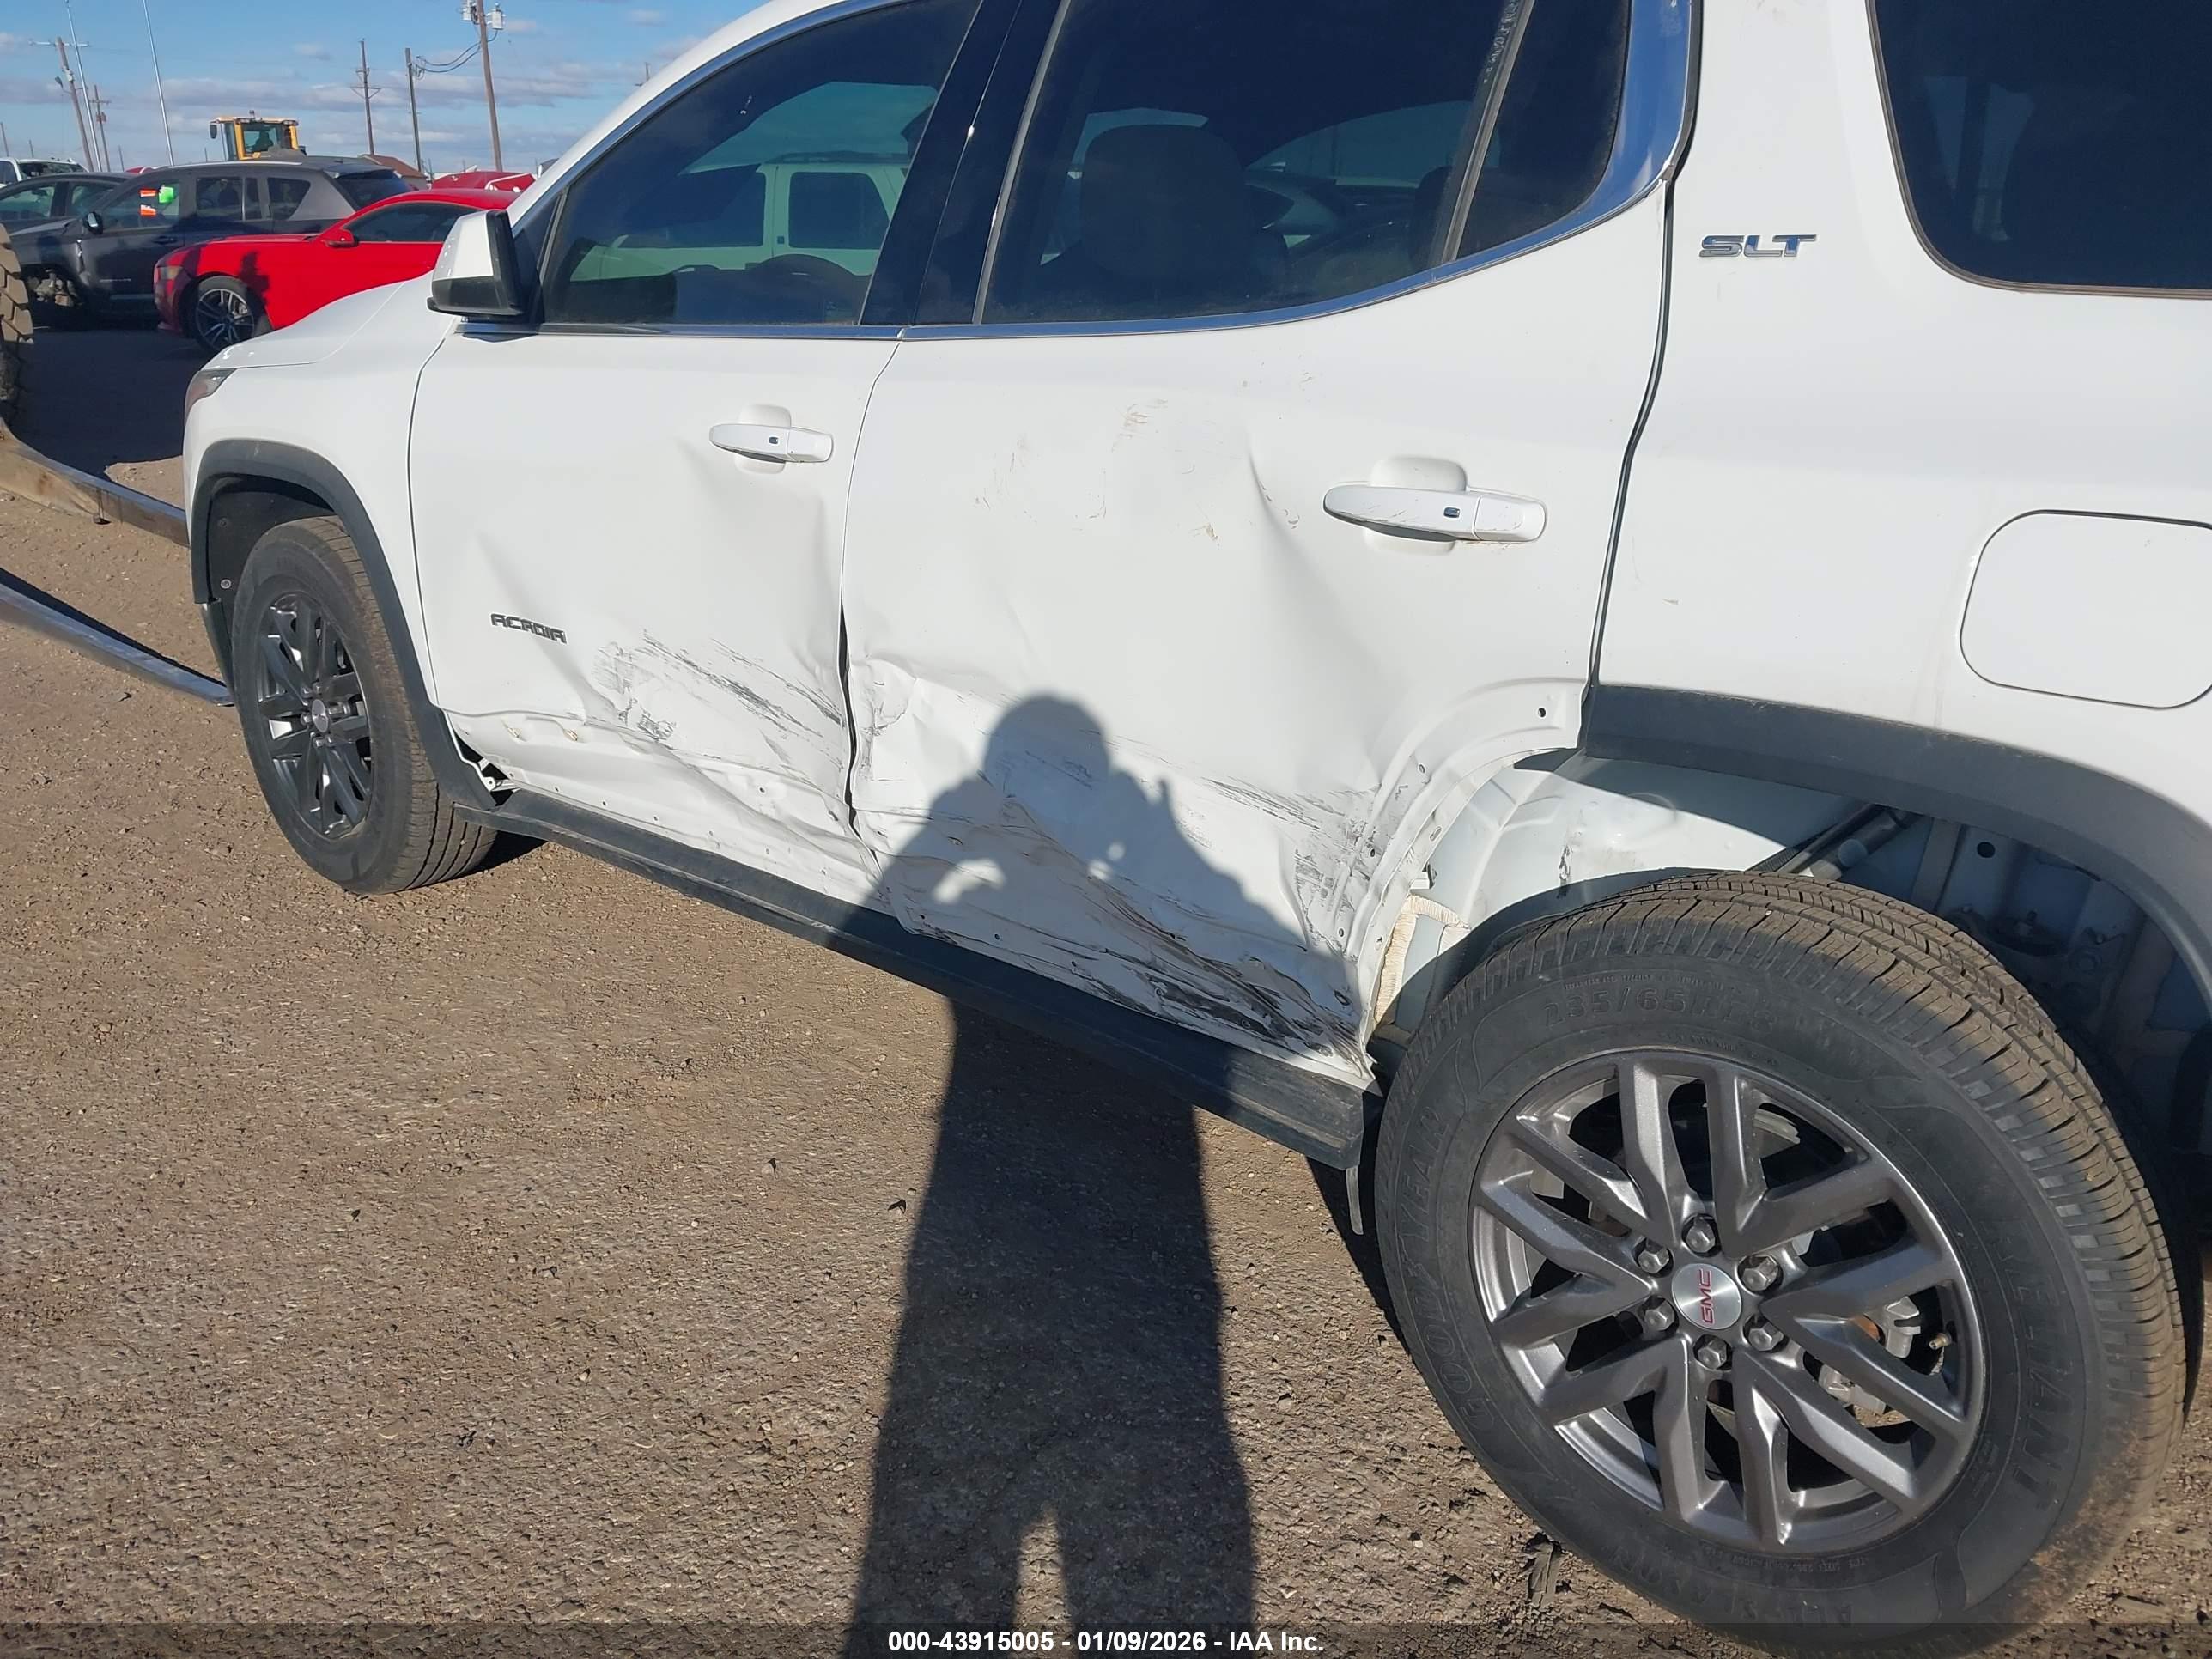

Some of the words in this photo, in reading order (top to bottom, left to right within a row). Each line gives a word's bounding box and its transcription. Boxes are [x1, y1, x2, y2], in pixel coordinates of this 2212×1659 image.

[1698, 234, 1817, 258] SLT
[489, 613, 568, 644] ACADIA
[1697, 1269, 1717, 1325] GMC
